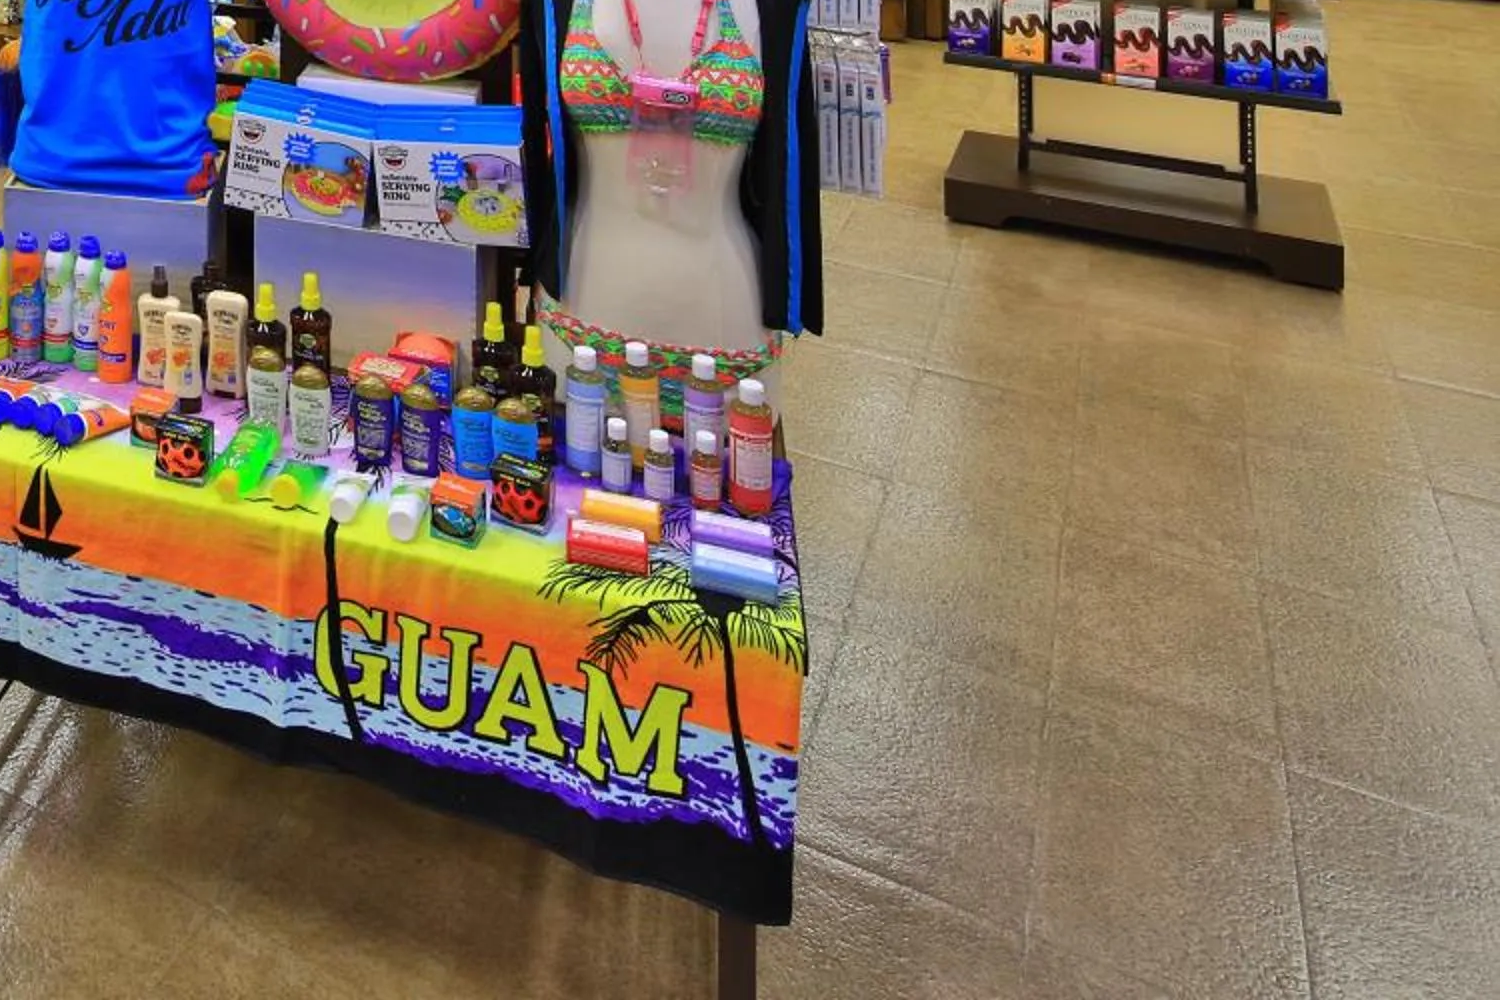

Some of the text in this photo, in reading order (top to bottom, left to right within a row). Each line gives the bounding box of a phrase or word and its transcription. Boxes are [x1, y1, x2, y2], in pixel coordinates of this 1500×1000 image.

[235, 152, 281, 169] SERVING
[234, 161, 260, 174] RING
[382, 181, 431, 193] SERVING
[383, 191, 411, 201] RING
[313, 598, 693, 798] GUAM
